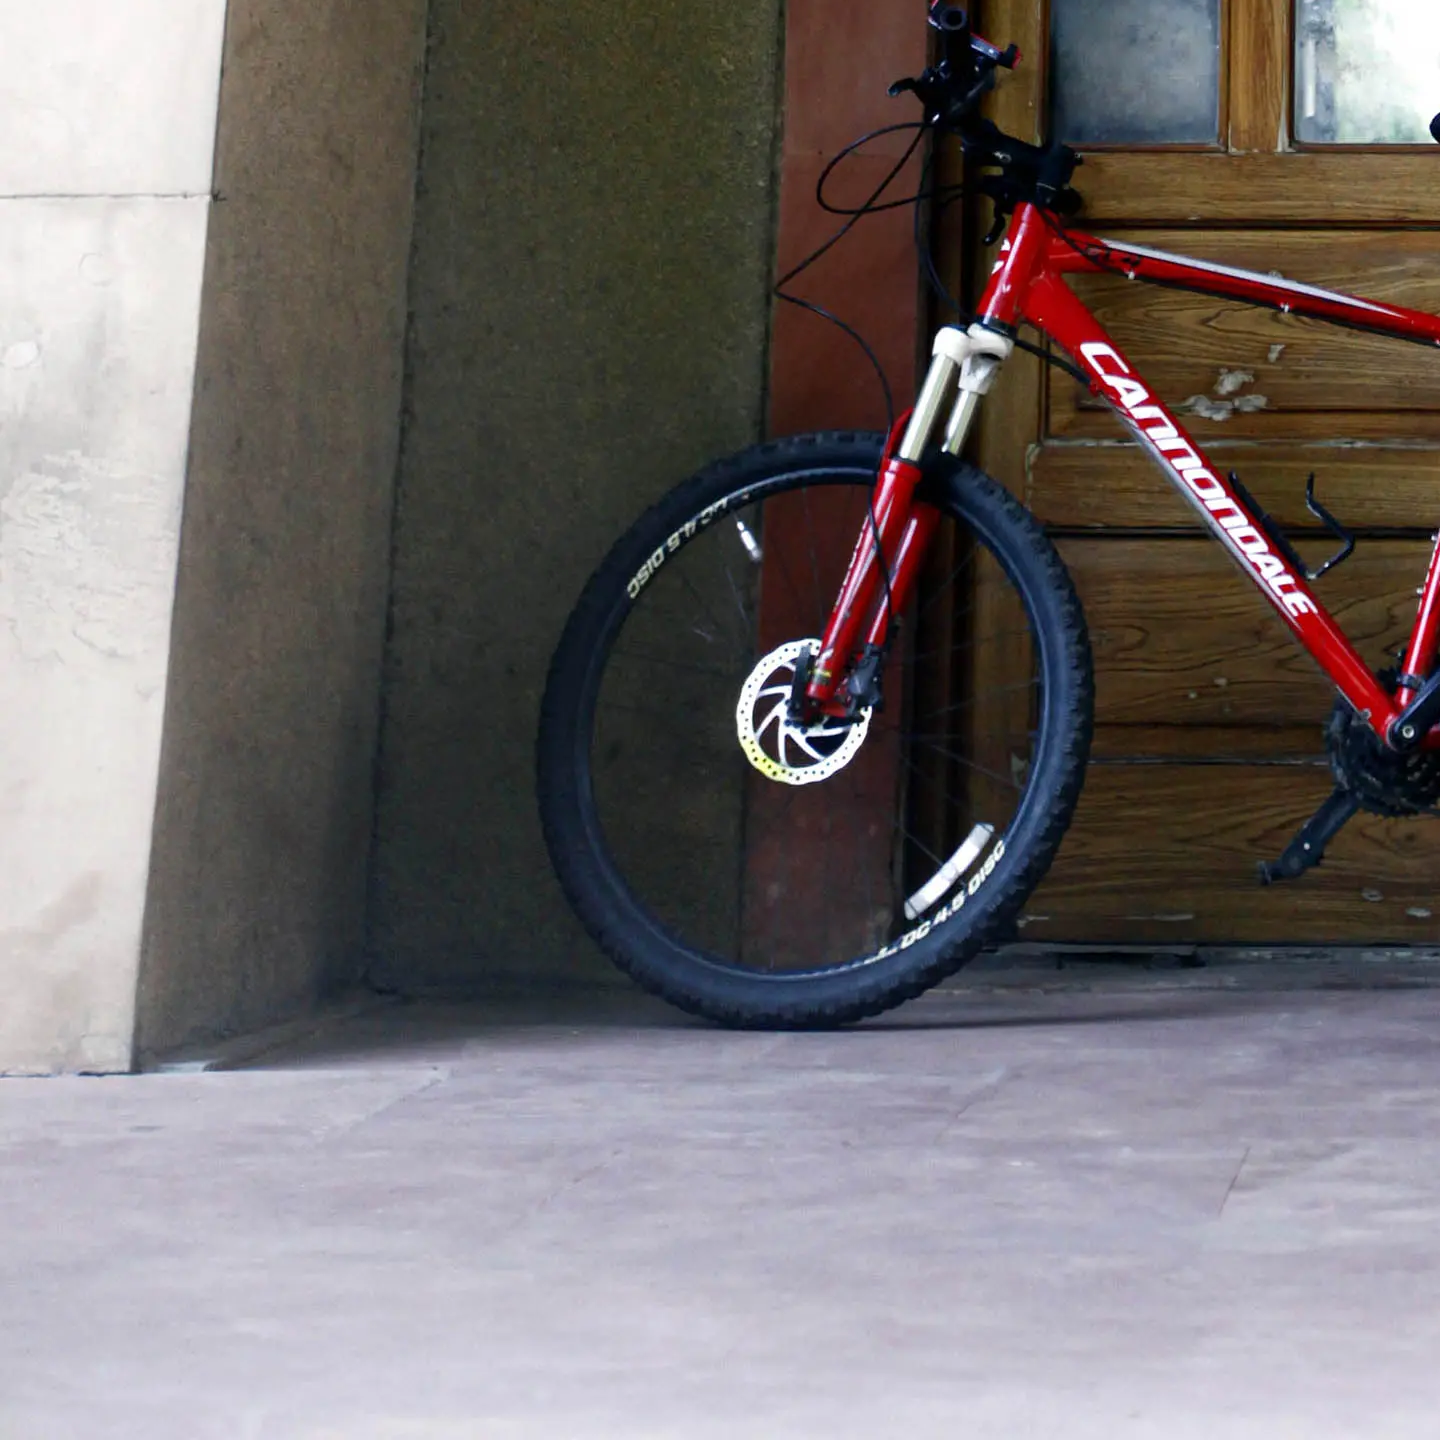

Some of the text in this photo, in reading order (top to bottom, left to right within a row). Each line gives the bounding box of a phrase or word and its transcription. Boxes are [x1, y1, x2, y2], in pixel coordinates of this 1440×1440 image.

[626, 546, 665, 599] DISC
[900, 920, 932, 950] DC
[967, 839, 1006, 896] DISC
